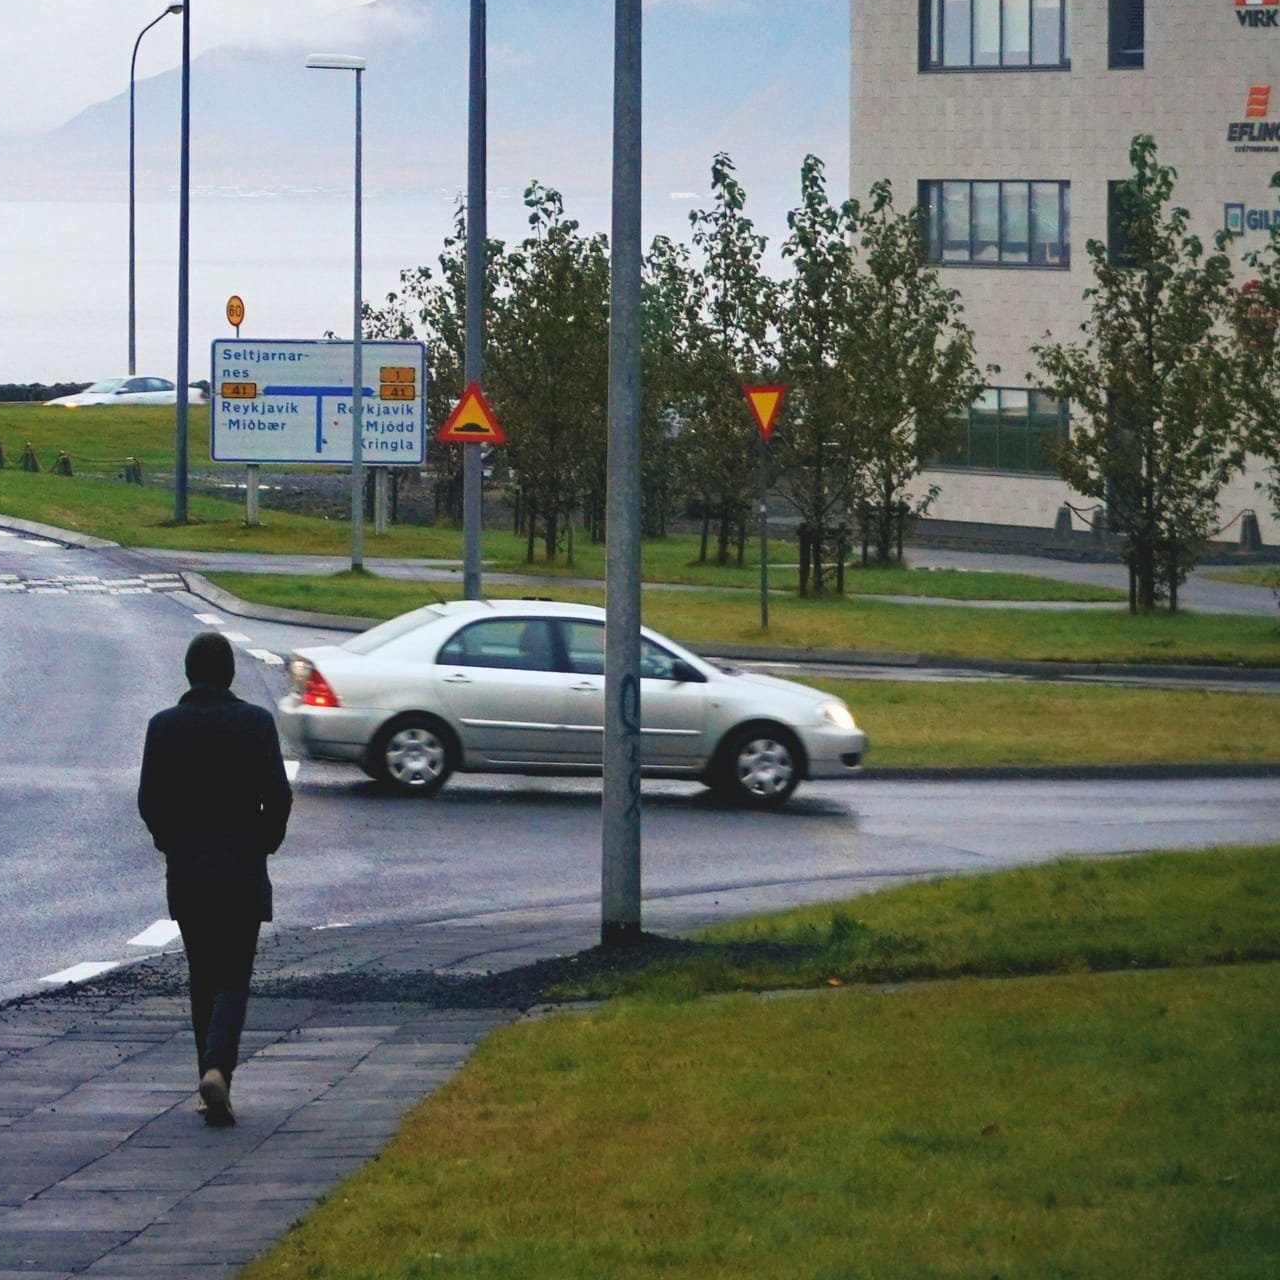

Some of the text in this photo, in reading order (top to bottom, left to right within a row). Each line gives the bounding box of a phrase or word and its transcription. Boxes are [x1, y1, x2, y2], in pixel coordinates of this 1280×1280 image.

[1235, 9, 1278, 27] VIRK
[228, 304, 242, 317] 60
[223, 349, 310, 363] Seltjarnar-
[222, 368, 249, 378] nes
[231, 385, 247, 395] 41
[390, 387, 406, 397] 41
